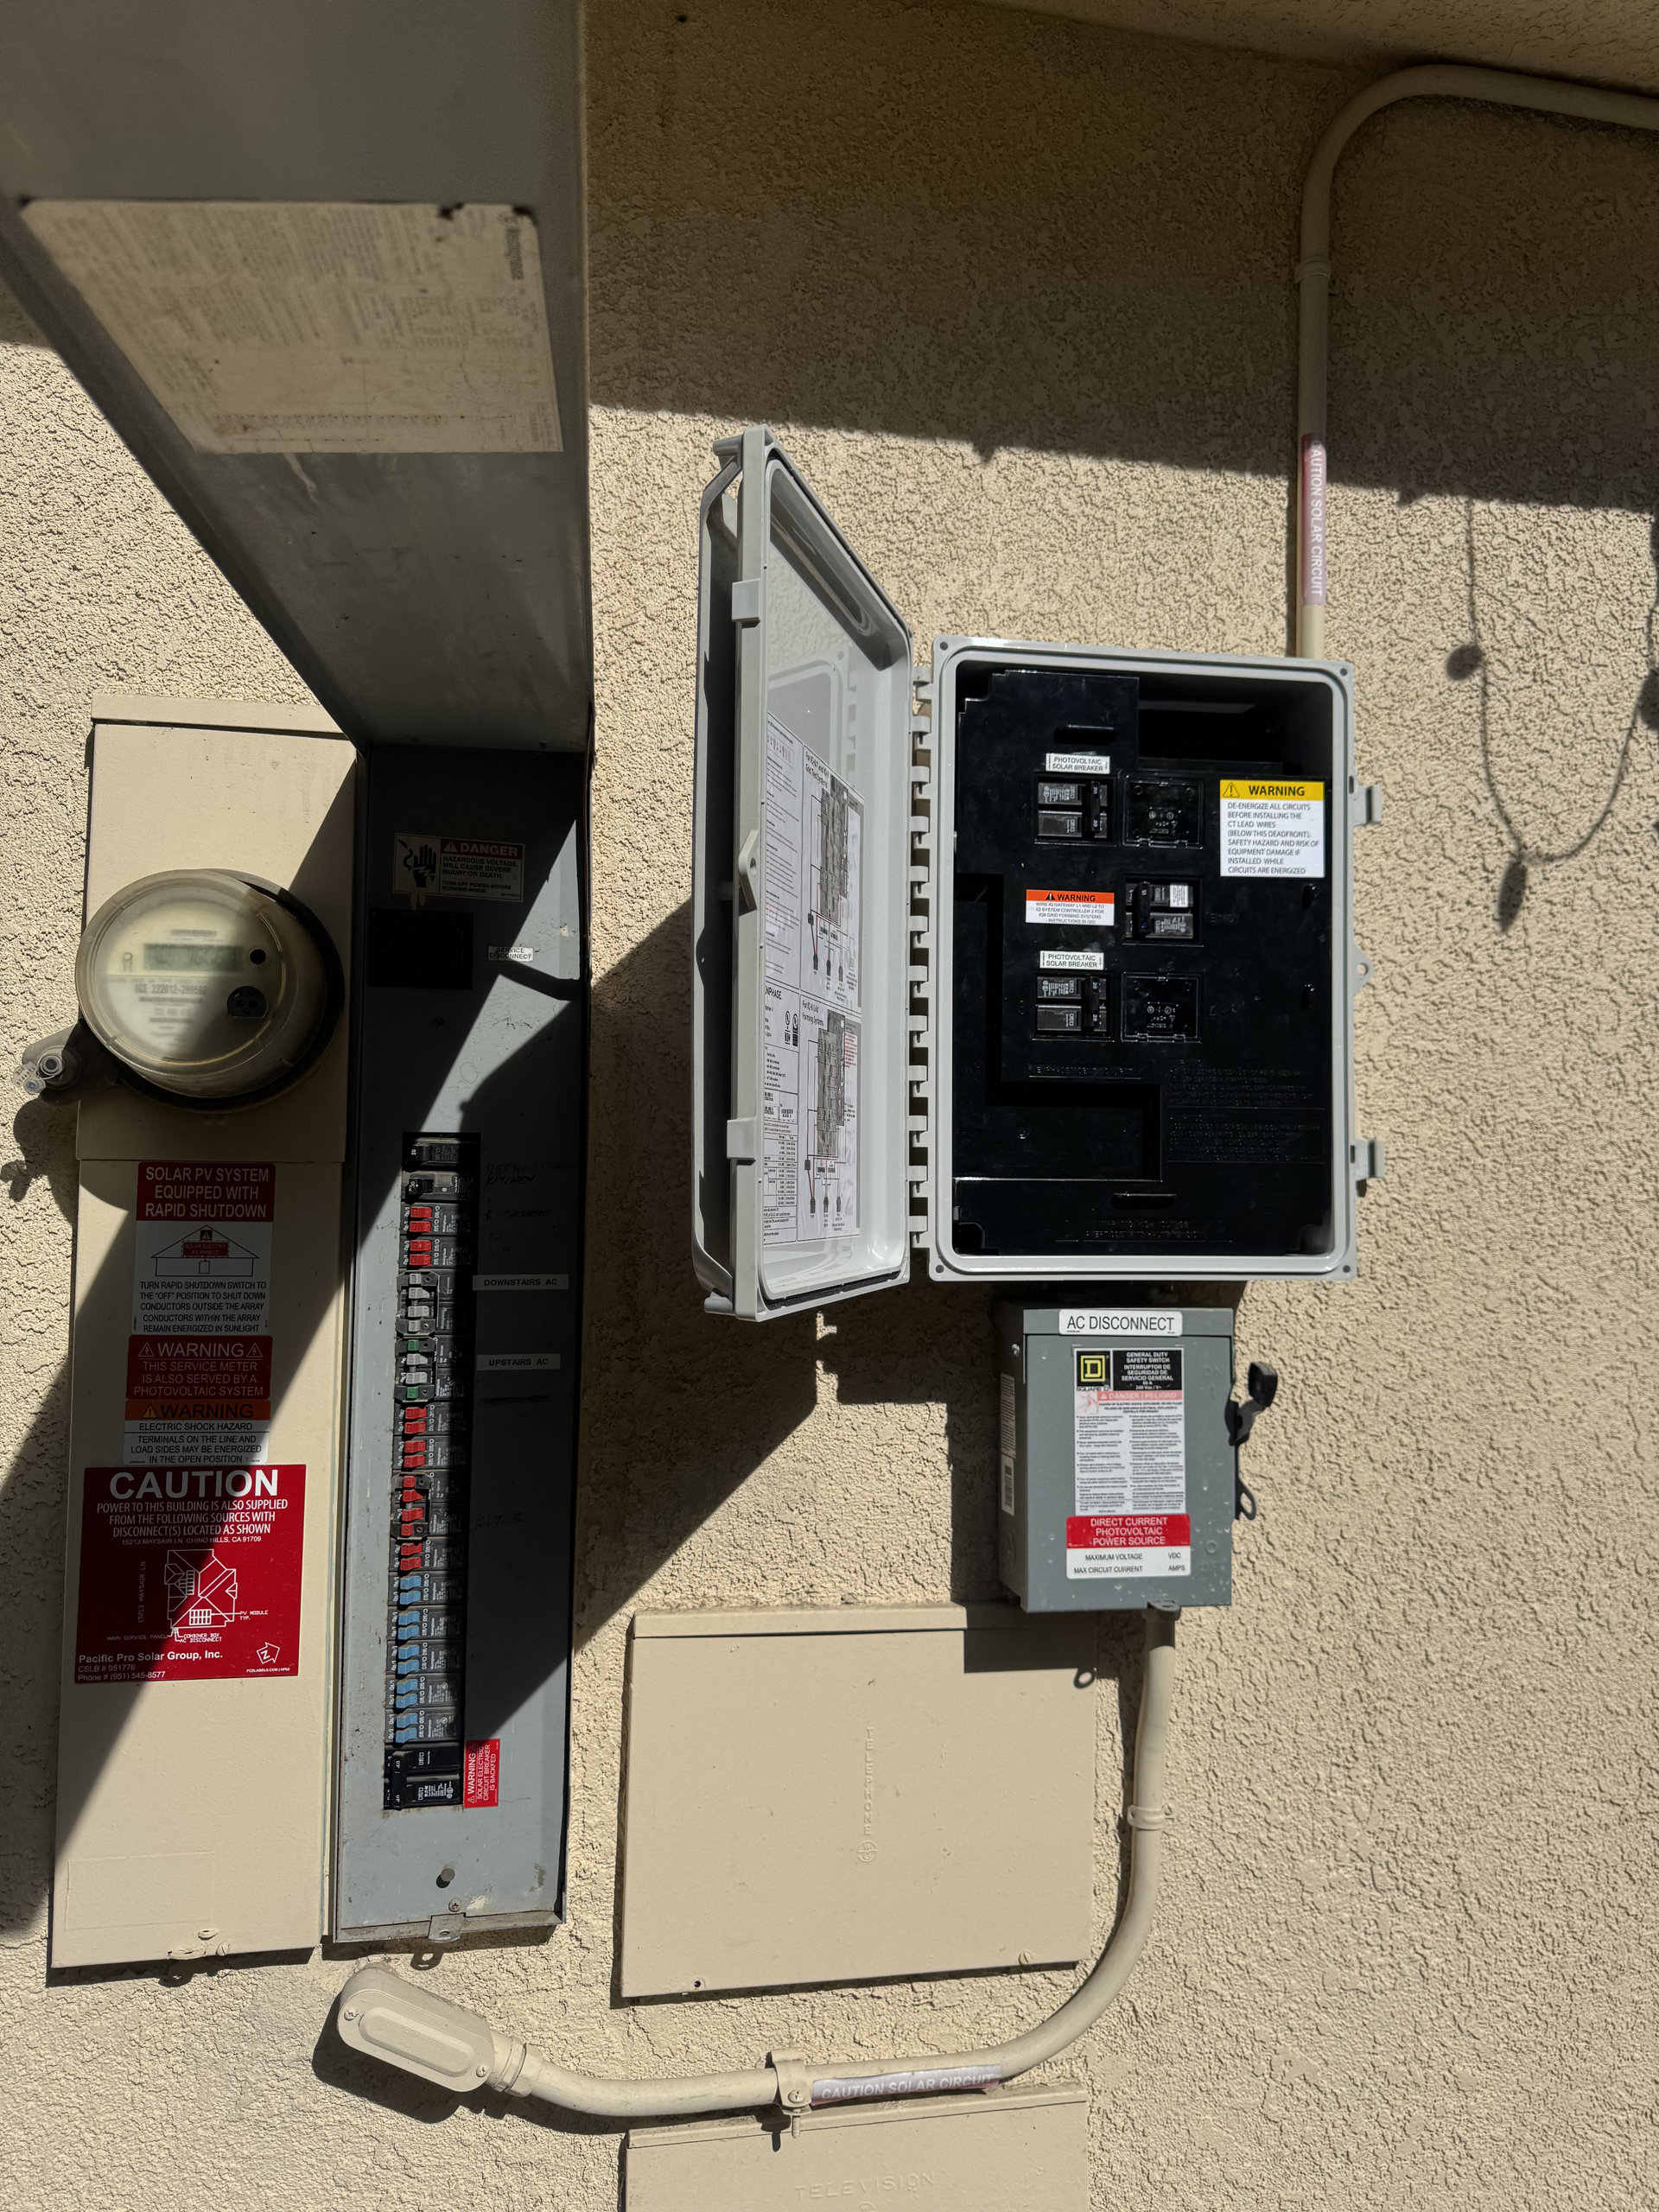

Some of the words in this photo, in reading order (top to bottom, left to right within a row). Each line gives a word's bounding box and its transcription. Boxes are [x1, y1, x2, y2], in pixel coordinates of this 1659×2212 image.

[1311, 440, 1322, 495] CAUTION
[1311, 500, 1322, 542] SOLAR
[1311, 548, 1322, 596] CIRCUIT
[1249, 786, 1305, 796] WARNING
[460, 843, 518, 856] DANGER
[1057, 894, 1095, 902] WARNING
[146, 1167, 191, 1181] SOLAR
[195, 1168, 213, 1181] PV
[216, 1168, 269, 1182] SYSTEM
[155, 1185, 221, 1199] EQUIPPED
[226, 1186, 258, 1199] WITH
[145, 1203, 186, 1217] RAPID
[190, 1204, 266, 1217] SHUTDOWN
[1067, 1316, 1085, 1329] AC
[1090, 1316, 1174, 1330] DISCONNECT
[157, 1343, 244, 1357] WARNING
[143, 1362, 167, 1371] THIS
[170, 1362, 216, 1371] SERVICE
[220, 1362, 257, 1371] METER
[143, 1374, 152, 1383] IS
[155, 1374, 183, 1383] ALSO
[186, 1374, 230, 1383] SERVED
[233, 1374, 247, 1383] BY
[249, 1374, 257, 1383] A
[134, 1387, 216, 1396] PHOTOVOLTAIC
[219, 1387, 263, 1396] SYSTEM
[161, 1404, 253, 1418] WARNING
[110, 1470, 278, 1499] CAUTION
[97, 1503, 130, 1513] POWER
[132, 1503, 142, 1512] TO
[145, 1502, 164, 1511] THIS
[166, 1501, 209, 1511] BUILDING
[211, 1501, 219, 1510] IS
[221, 1500, 243, 1511] ALSO
[246, 1499, 287, 1510] SUPPLIED
[109, 1515, 135, 1525] FROM
[138, 1515, 154, 1524] THE
[156, 1514, 209, 1523] FOLLOWING
[211, 1512, 250, 1522] SOURCES
[252, 1512, 275, 1522] WITH
[1091, 1518, 1123, 1526] DIRECT
[1125, 1517, 1168, 1526] CURRENT
[113, 1527, 181, 1537] DISCONNECT(S)
[183, 1526, 221, 1536] LOCATED
[223, 1525, 234, 1534] AS
[237, 1524, 270, 1534] SHOWN
[1096, 1527, 1163, 1536] PHOTOVOLTAIC
[1093, 1537, 1126, 1546] POWER
[1129, 1536, 1165, 1545] SOURCE
[167, 1652, 202, 1661] Group,
[468, 1753, 476, 1794] WARNING
[864, 1727, 873, 1835] TELEPHONE
[822, 2084, 885, 2100] CAUTION
[888, 2078, 935, 2093] SOLAR
[940, 2074, 994, 2089] CIRCUIT
[795, 2171, 934, 2200] TELEVISION
